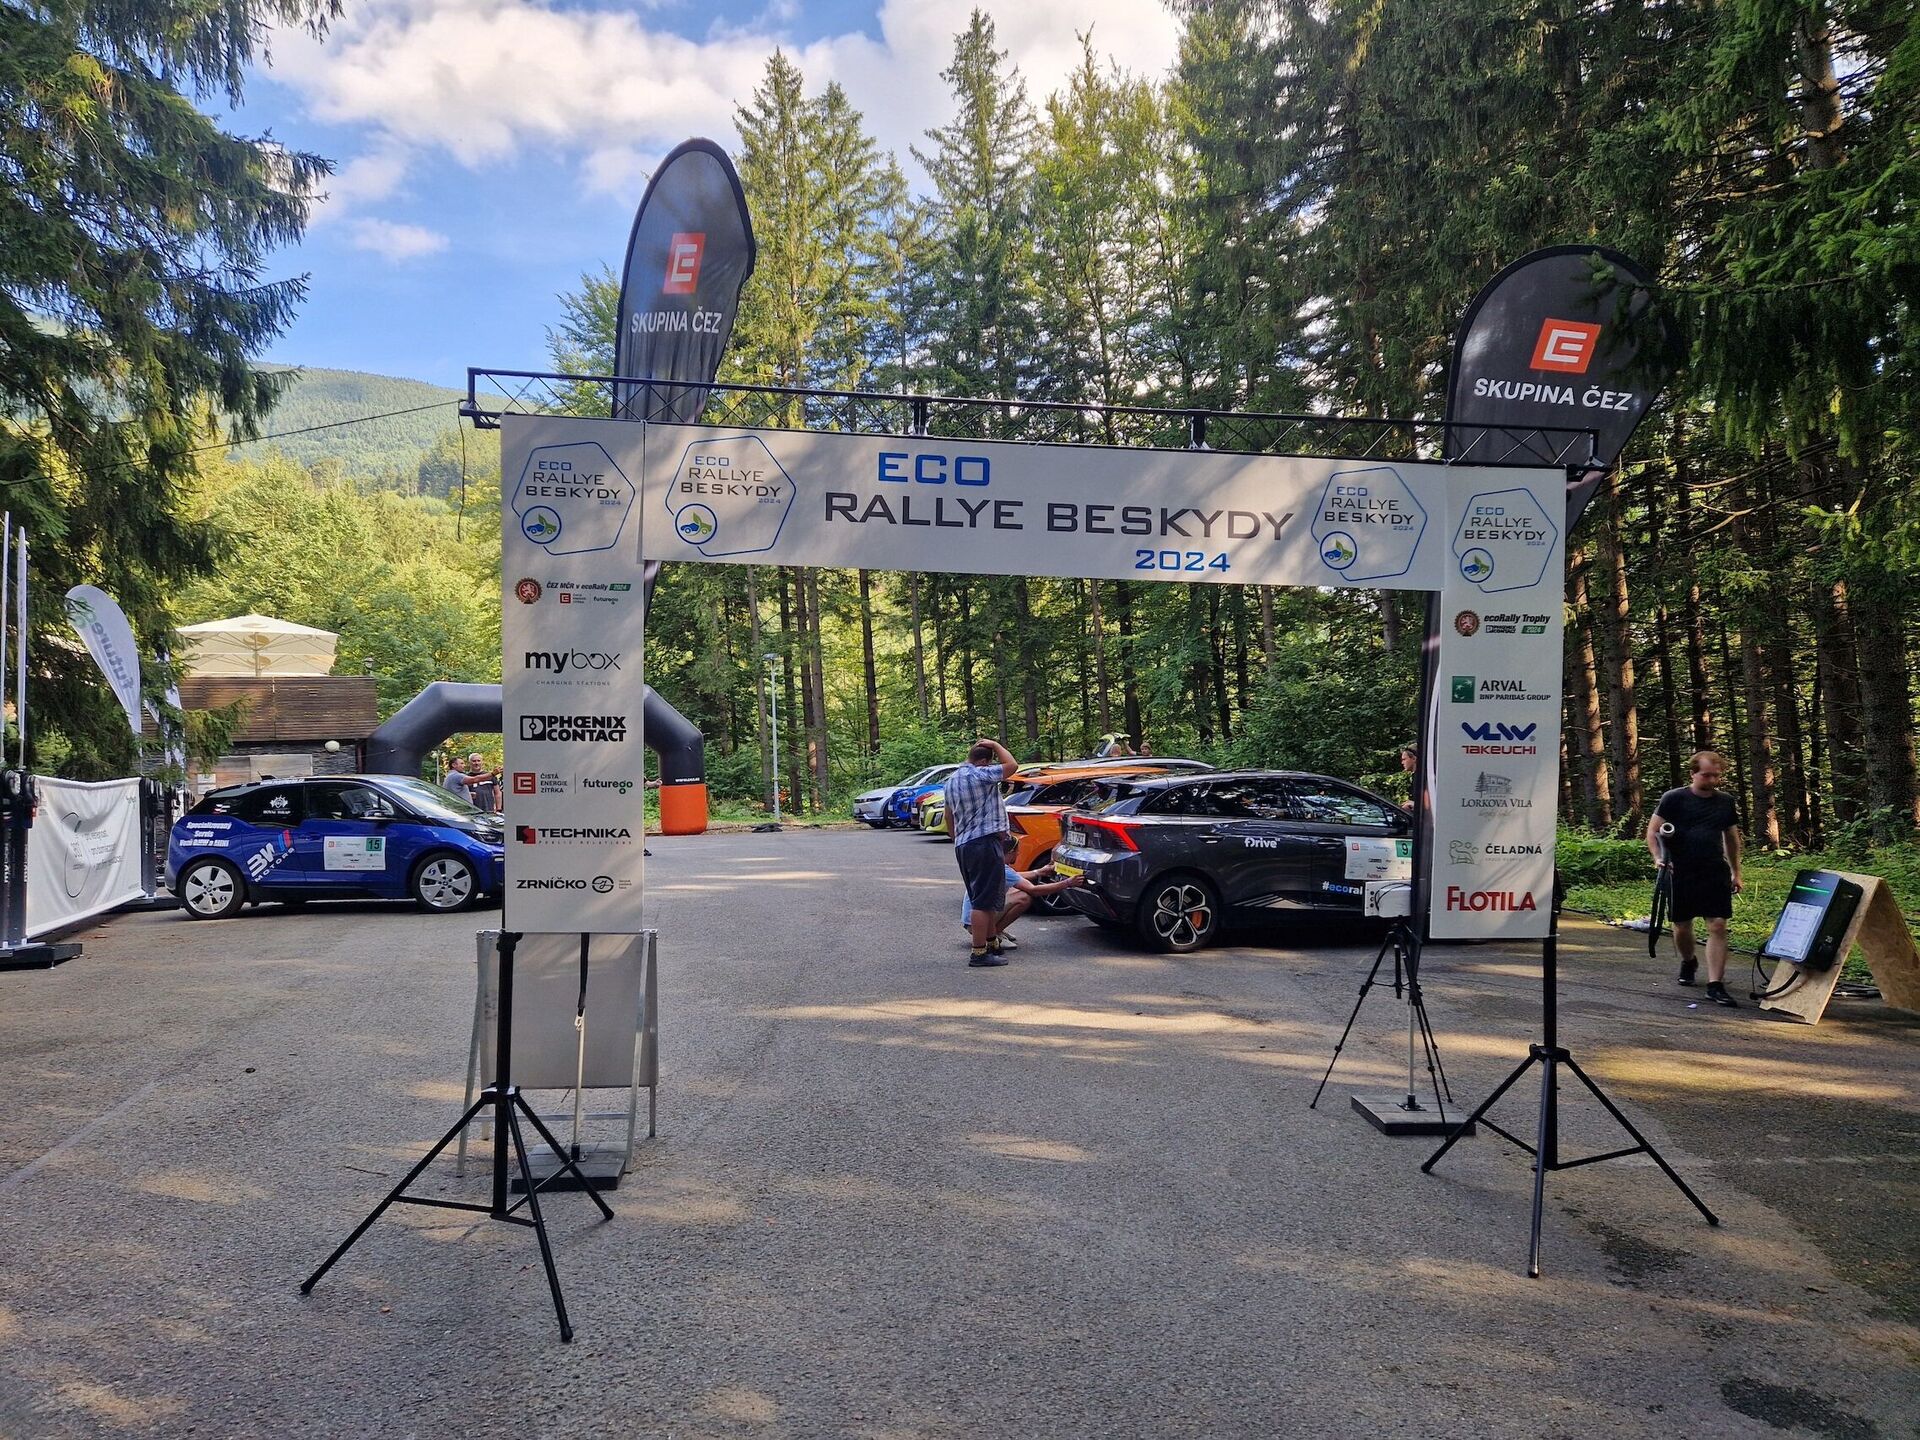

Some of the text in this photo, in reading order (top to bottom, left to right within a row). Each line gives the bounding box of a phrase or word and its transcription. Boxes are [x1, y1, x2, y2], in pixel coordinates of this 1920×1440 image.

[631, 305, 722, 334] SKUPINA ČEZ
[1473, 377, 1632, 411] SKUPINA ČEZ
[538, 461, 572, 471] ECO
[695, 455, 729, 467] ECO
[688, 466, 765, 483] RALLYE
[878, 451, 991, 486] ECO
[533, 471, 605, 486] RALLYE
[525, 485, 621, 500] BESKYDY
[681, 481, 782, 497] BESKYDY
[1337, 486, 1368, 496] ECO
[1331, 497, 1400, 511] RALLYE
[825, 491, 1294, 541] RALLYE BESKYDY
[1476, 506, 1505, 516] ECO
[1324, 511, 1414, 525] BESKYDY
[1471, 517, 1532, 528] RALLYE
[1464, 529, 1546, 541] BESKYDY
[1135, 548, 1231, 572] 2024
[546, 581, 559, 589] ČEZ
[581, 583, 609, 591] ecoRally
[1484, 613, 1551, 624] ecoRally Trophy
[1480, 680, 1527, 692] ARVAL
[547, 729, 627, 742] CONTACT
[1461, 745, 1537, 755] TAKEUCHI
[540, 772, 559, 780] ČISTÁ
[540, 786, 564, 794] ZÍTŘKA
[582, 778, 634, 795] futurego
[1461, 797, 1533, 808] LORKOVA VILA
[538, 828, 631, 839] TECHNIKA
[368, 839, 380, 850] 15
[1402, 842, 1409, 856] 9
[1485, 842, 1543, 855] ČELADNÁ
[254, 847, 295, 883] MOTORS
[516, 876, 587, 890] ZRNÍČKO
[1446, 885, 1537, 912] FLOTILA
